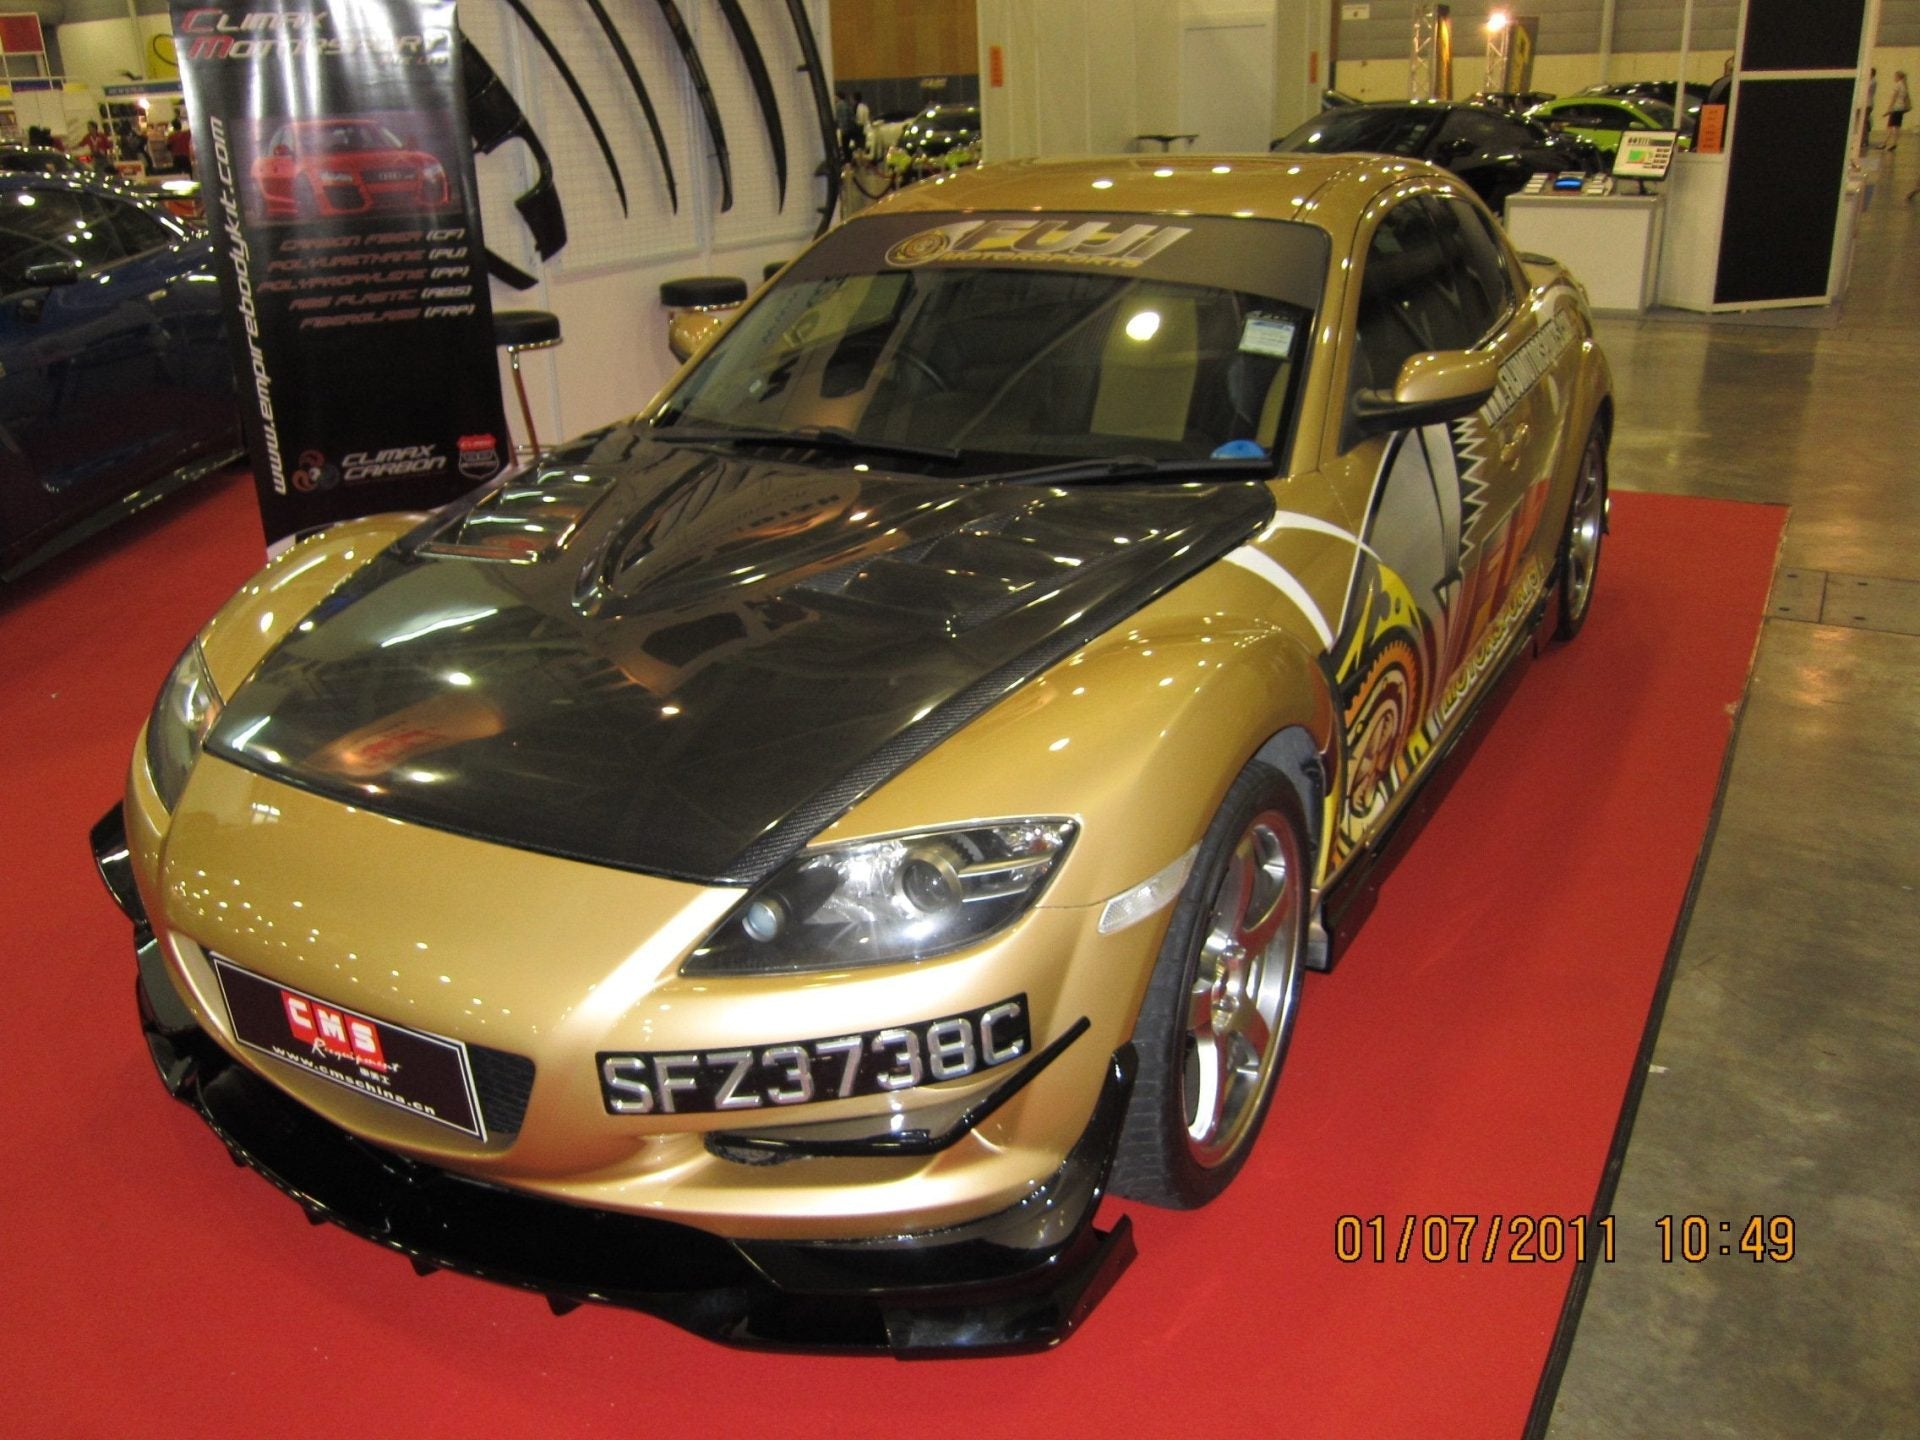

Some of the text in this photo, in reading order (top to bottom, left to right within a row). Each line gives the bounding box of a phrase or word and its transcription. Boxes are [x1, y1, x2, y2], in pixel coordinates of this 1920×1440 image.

[426, 228, 465, 241] (CF)
[952, 219, 1193, 259] FUJI
[428, 246, 468, 260] (PU)
[430, 265, 470, 279] (PP)
[421, 285, 473, 299] (ABS)
[209, 115, 287, 496] www.empirebodykit.com
[424, 304, 476, 319] (FRP)
[341, 443, 437, 468] CLIMAX
[343, 455, 447, 481] CARBON
[288, 997, 377, 1054] CMS
[602, 1001, 1025, 1114] SFZ3738C
[272, 1045, 436, 1116] www.cmschina.cn
